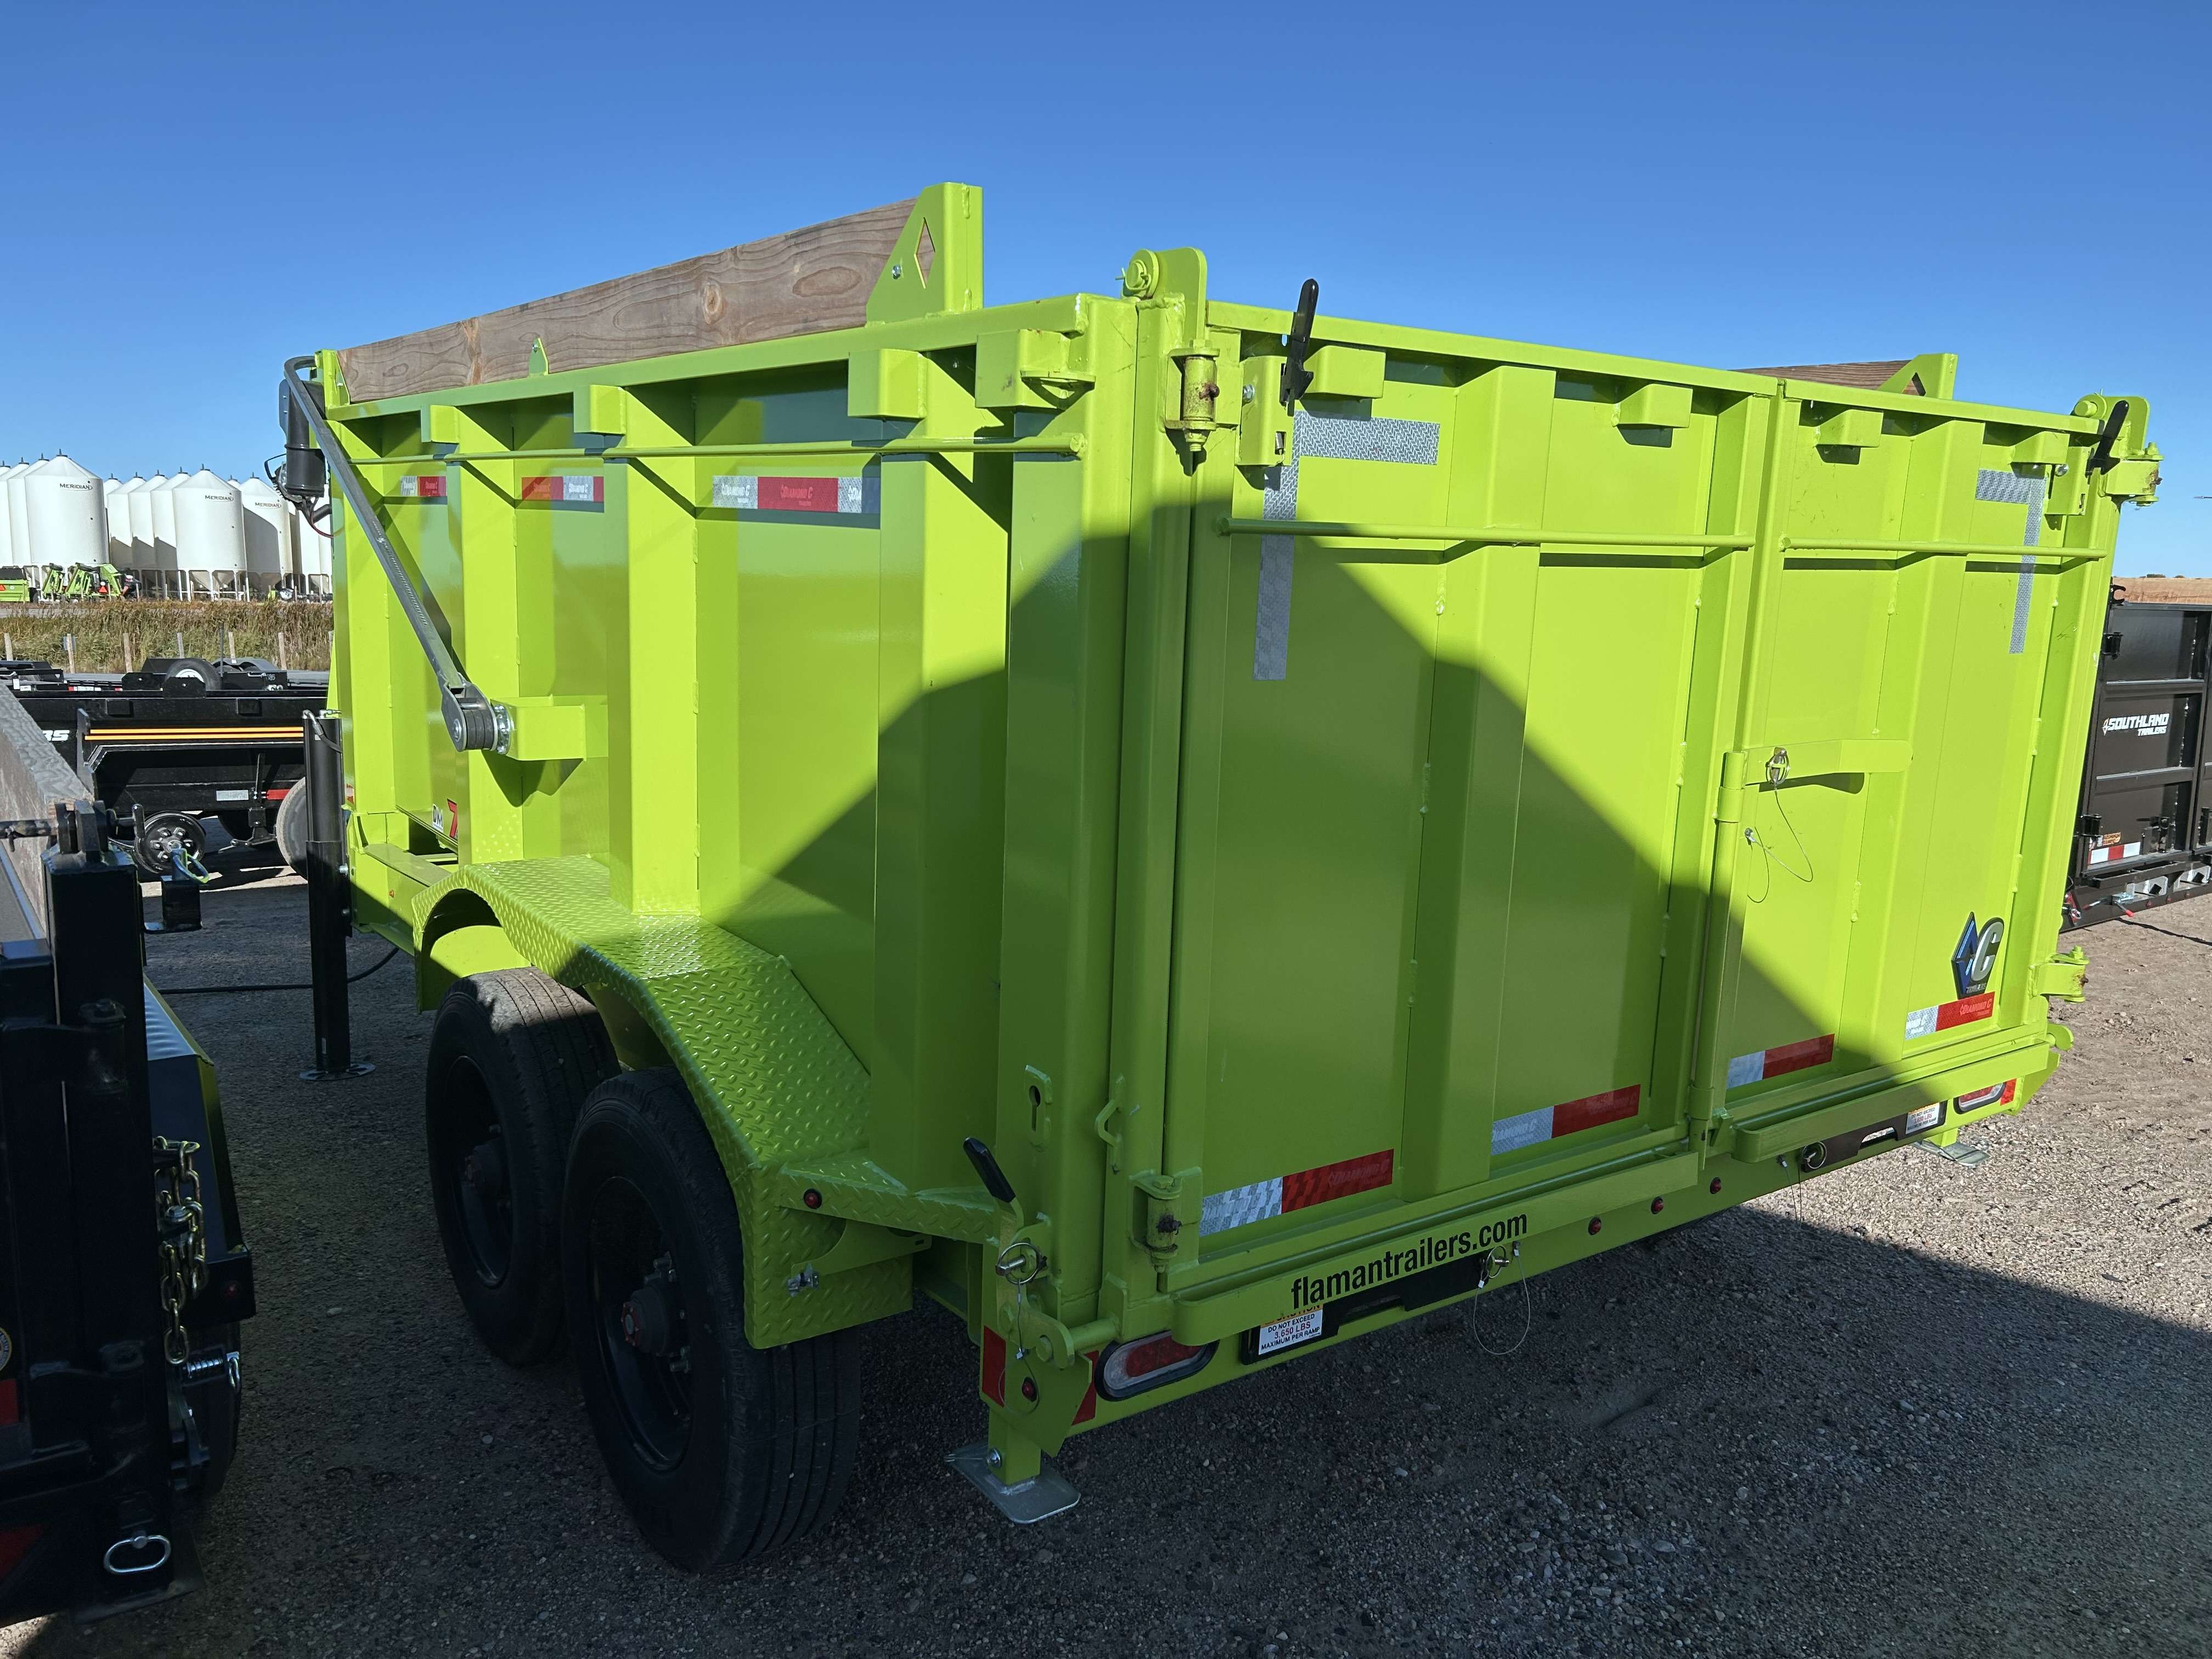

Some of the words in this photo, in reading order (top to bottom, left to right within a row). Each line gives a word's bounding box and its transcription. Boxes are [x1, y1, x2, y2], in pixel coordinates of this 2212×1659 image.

[2107, 713, 2169, 731] SOUTHLAND
[2137, 726, 2167, 736] TRAILERS
[1291, 1214, 1527, 1310] flamantrailers.com
[1292, 1313, 1315, 1325] EXCEED
[1261, 1336, 1290, 1350] MAXIMUM
[1291, 1332, 1303, 1340] PER
[1305, 1327, 1320, 1335] RAMP
[1274, 1327, 1294, 1339] 3,650
[1296, 1321, 1311, 1333] LBS
